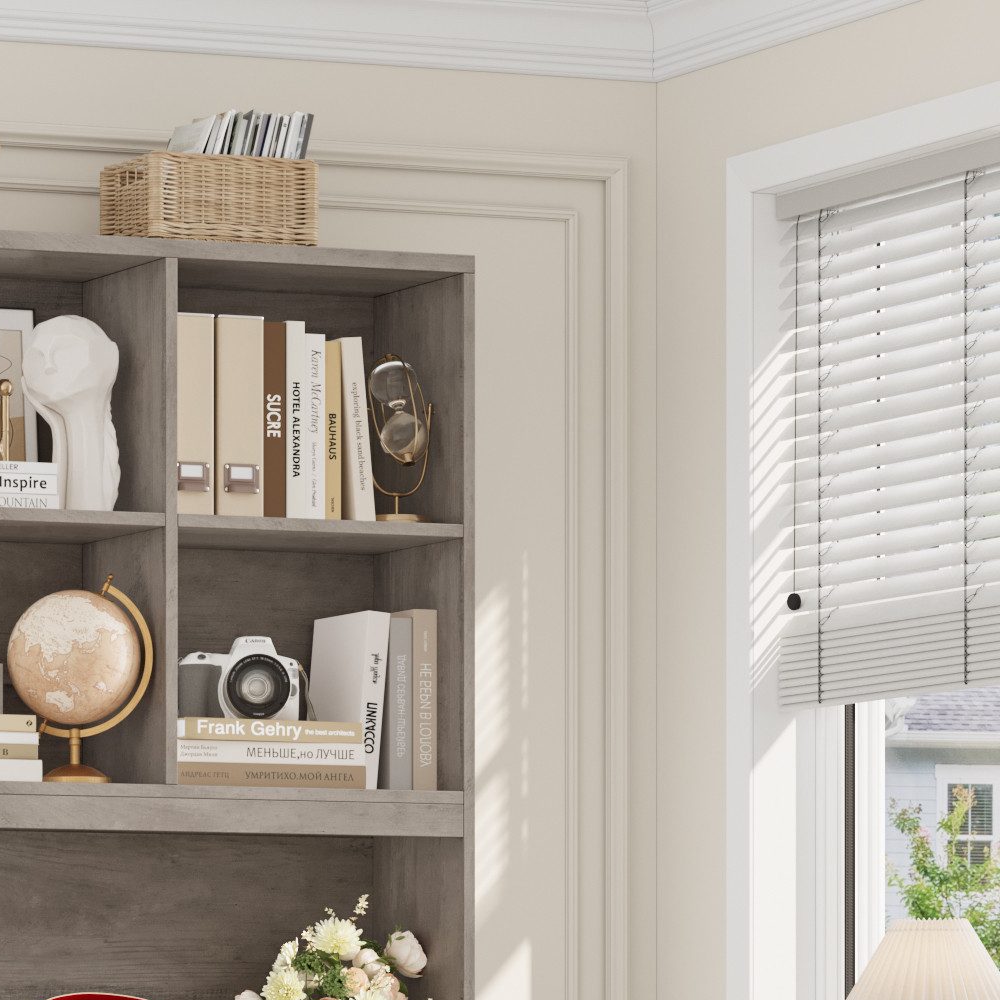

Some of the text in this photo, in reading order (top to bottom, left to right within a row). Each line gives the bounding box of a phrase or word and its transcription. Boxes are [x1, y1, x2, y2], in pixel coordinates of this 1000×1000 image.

[312, 350, 321, 378] Karen
[308, 382, 321, 434] McCartney
[351, 382, 360, 418] exploring
[267, 394, 281, 438] SUCRE
[0, 476, 47, 491] Inspire
[197, 720, 245, 735] Frank
[251, 721, 301, 740] Gehry
[316, 749, 355, 760] ЛУЧШЕ
